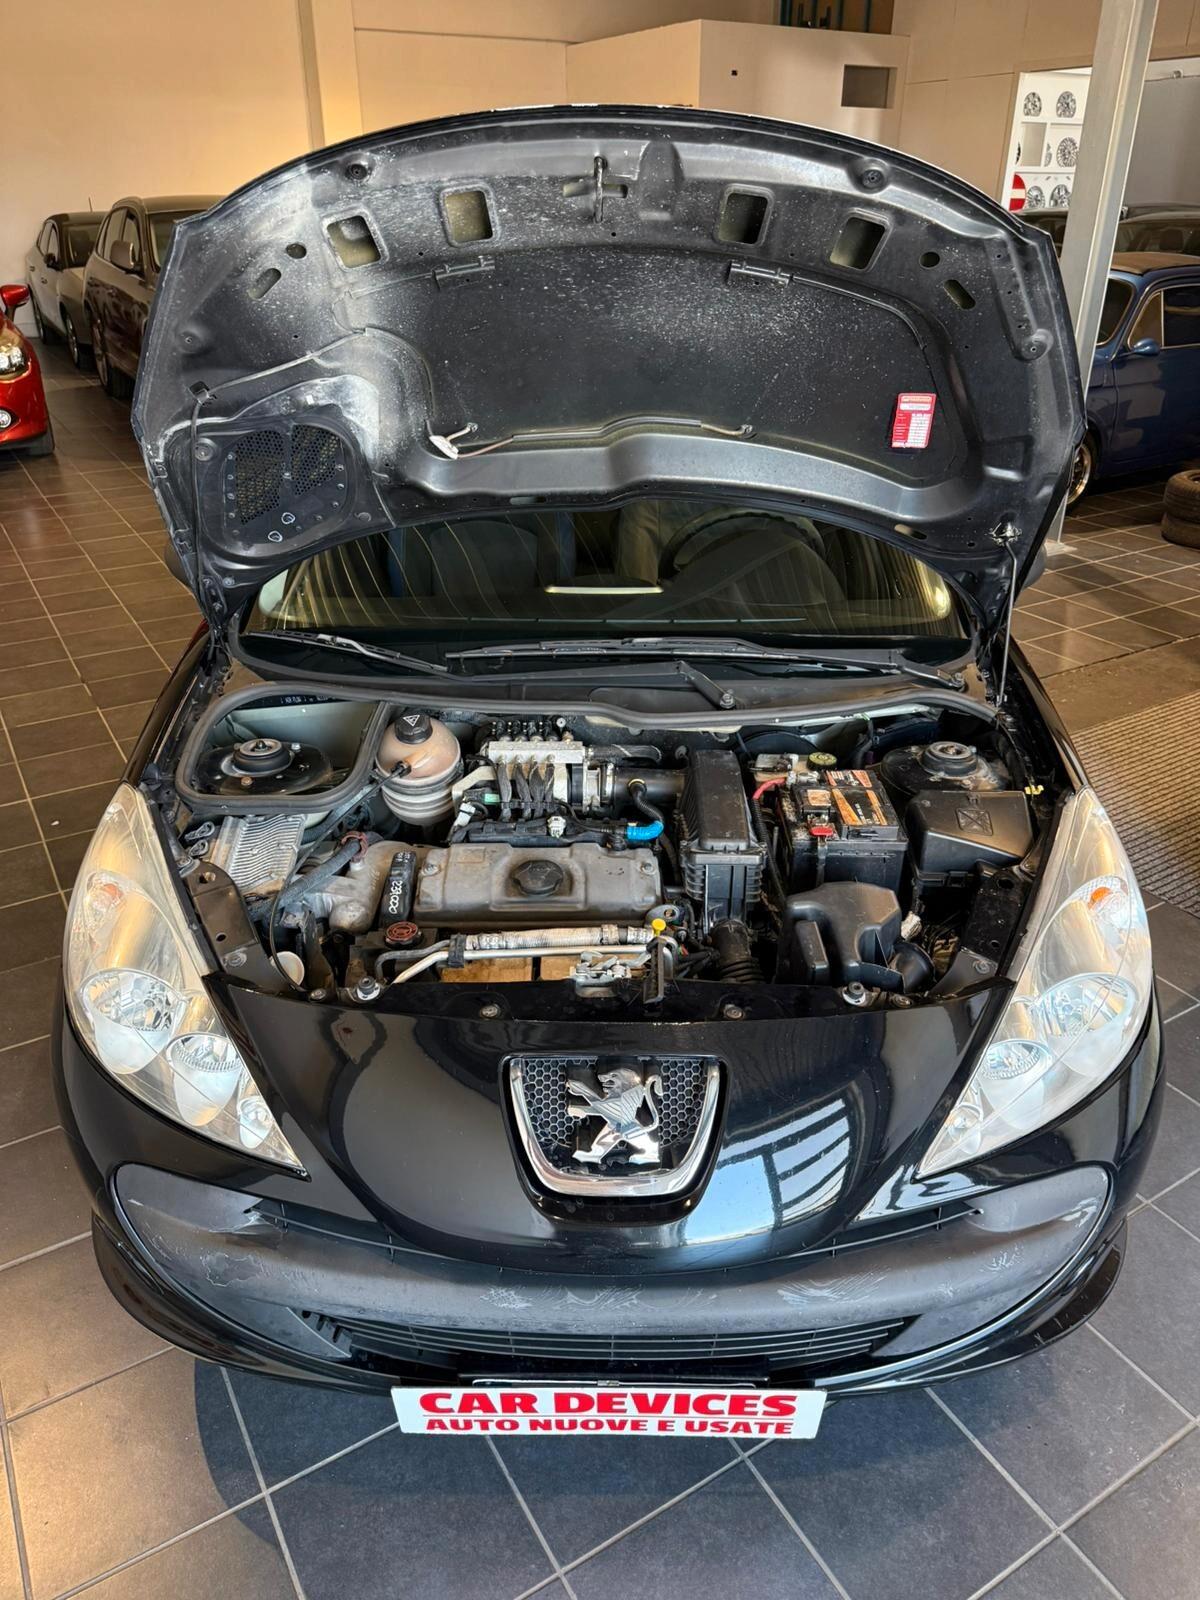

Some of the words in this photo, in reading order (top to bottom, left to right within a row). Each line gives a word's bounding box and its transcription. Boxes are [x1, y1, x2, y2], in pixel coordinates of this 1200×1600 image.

[418, 1392, 538, 1415] CAR
[553, 1392, 798, 1417] DEVICES
[425, 1418, 520, 1432] AUTO
[529, 1418, 649, 1432] NUOVE
[657, 1419, 675, 1433] E
[684, 1420, 794, 1435] USATE
